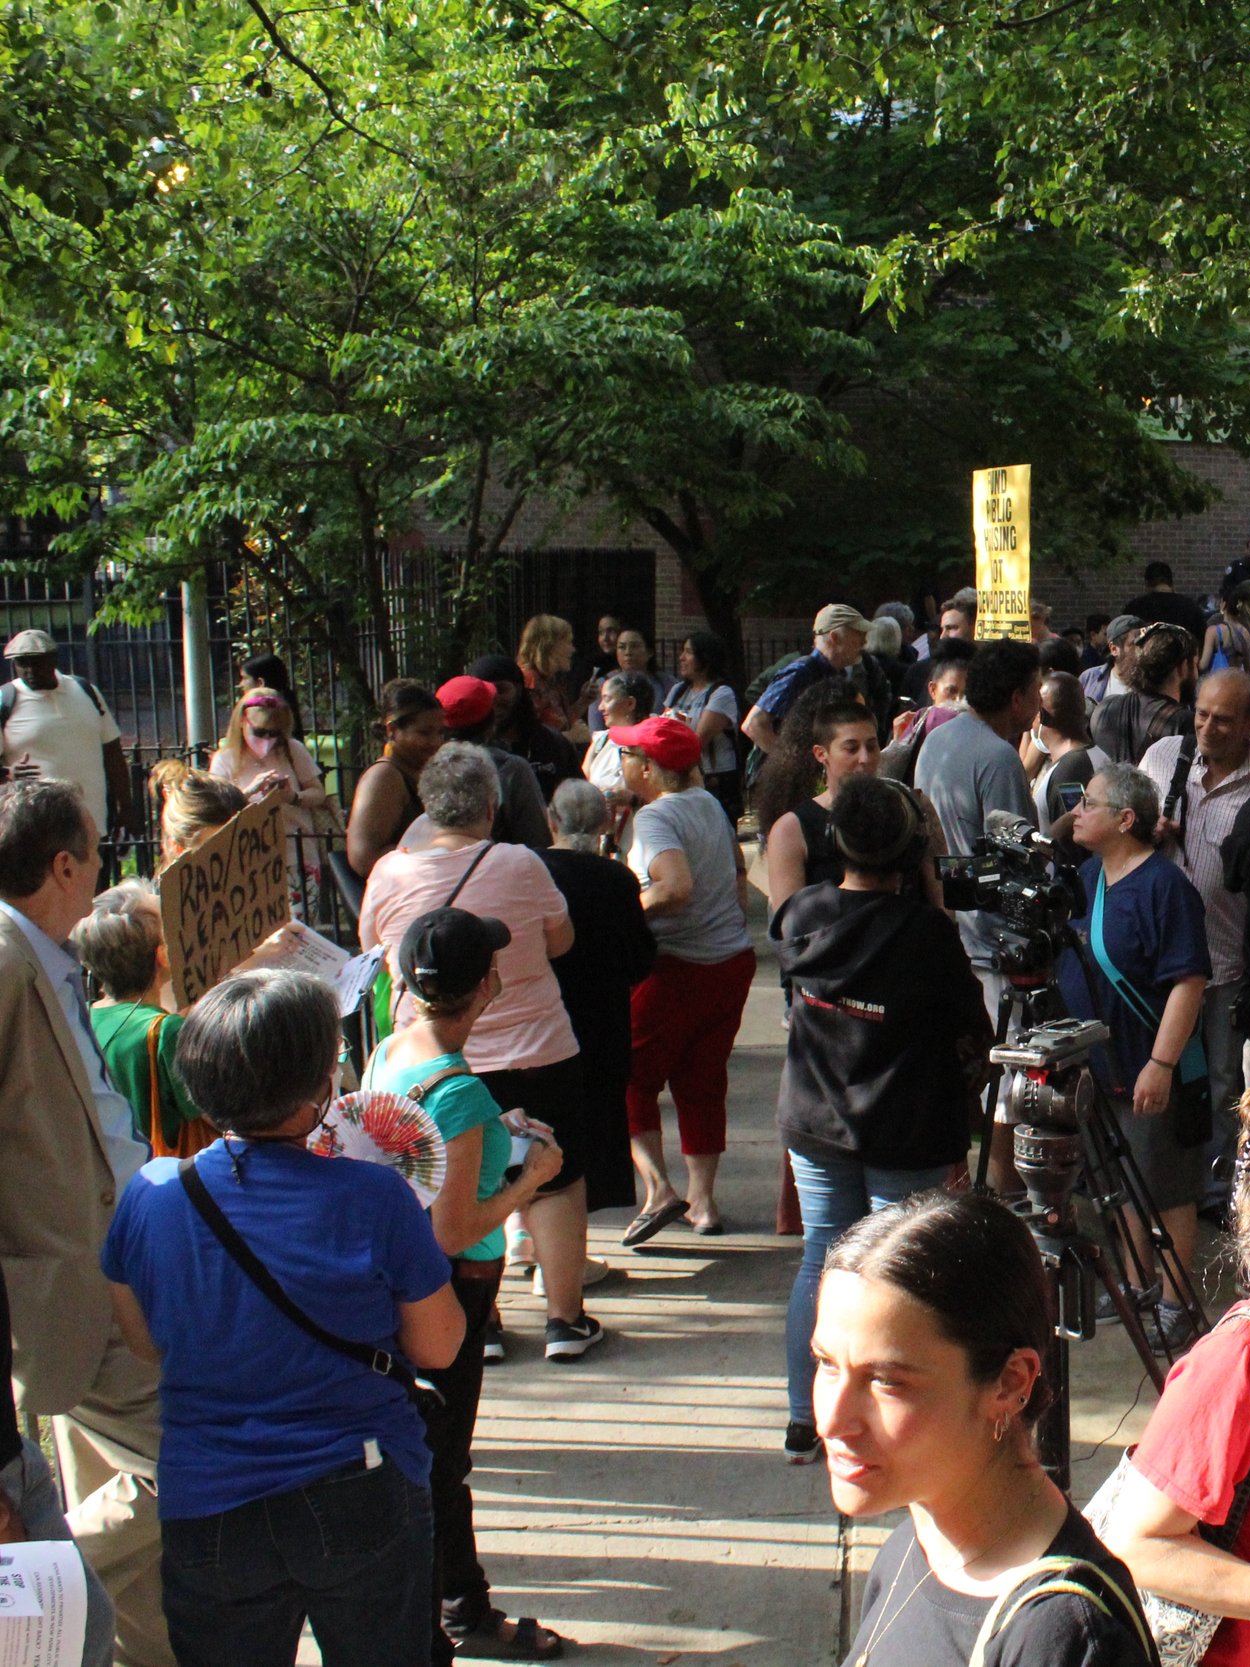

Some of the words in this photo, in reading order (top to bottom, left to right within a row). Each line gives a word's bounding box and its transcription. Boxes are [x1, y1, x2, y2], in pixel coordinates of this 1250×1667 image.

[179, 806, 281, 926] RAD/PACT
[179, 868, 257, 963] LEADS
[261, 854, 283, 894] TO
[183, 895, 285, 1003] EVICTIONS
[11, 1573, 25, 1589] STOP
